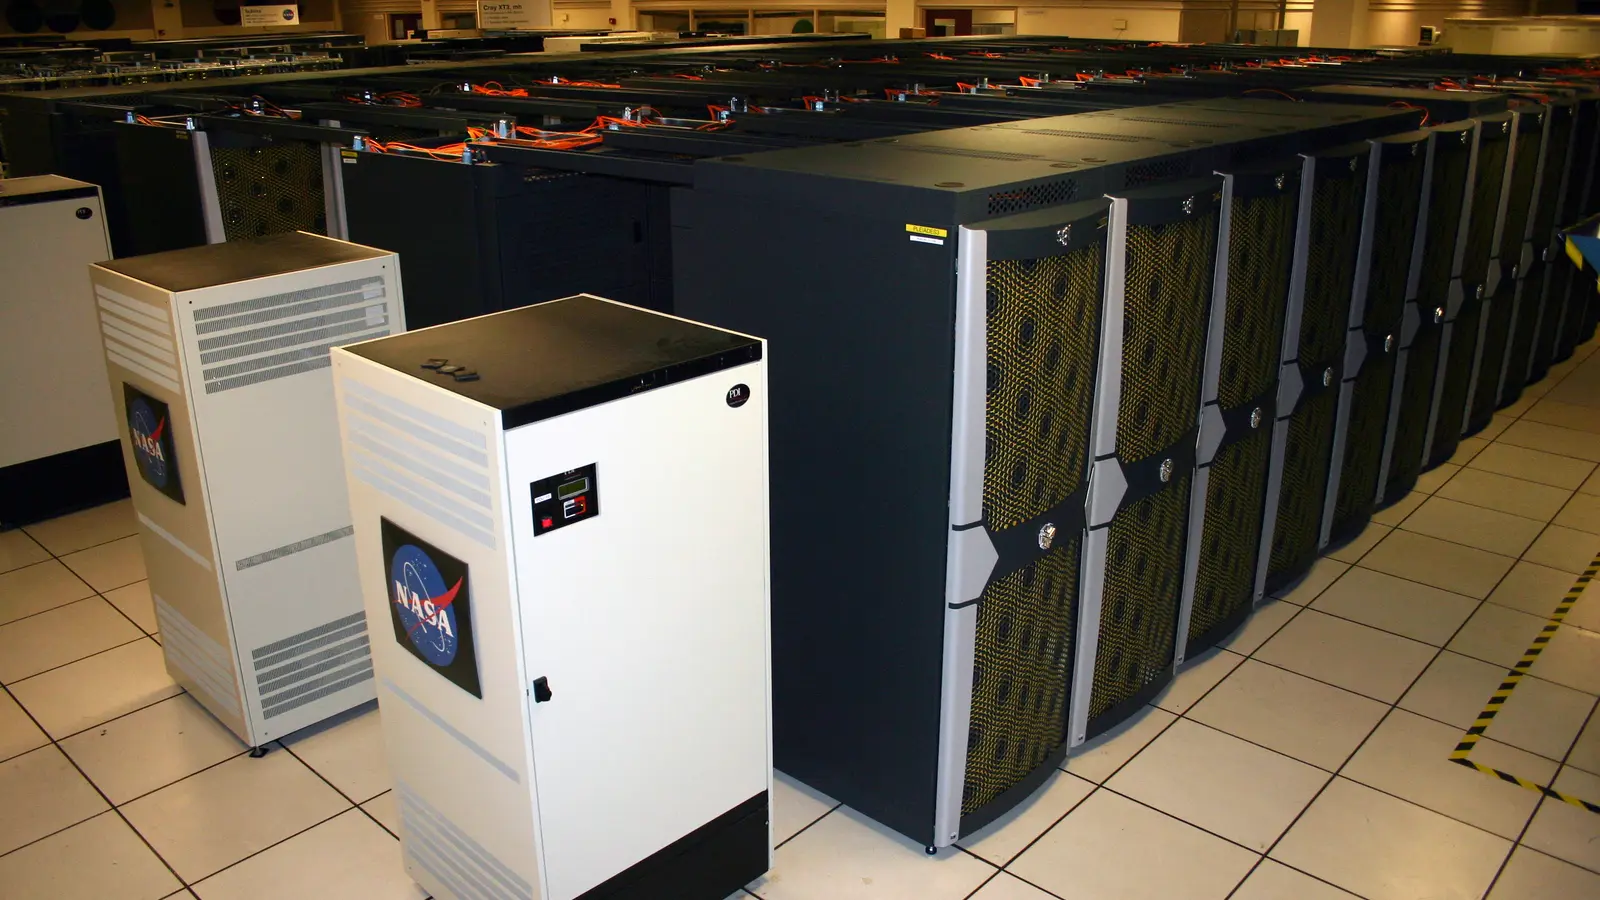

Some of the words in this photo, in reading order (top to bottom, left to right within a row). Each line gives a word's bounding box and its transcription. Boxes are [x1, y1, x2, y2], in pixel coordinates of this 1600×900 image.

[729, 387, 741, 399] PDI
[133, 428, 164, 462] NASA
[395, 580, 454, 638] NASA
